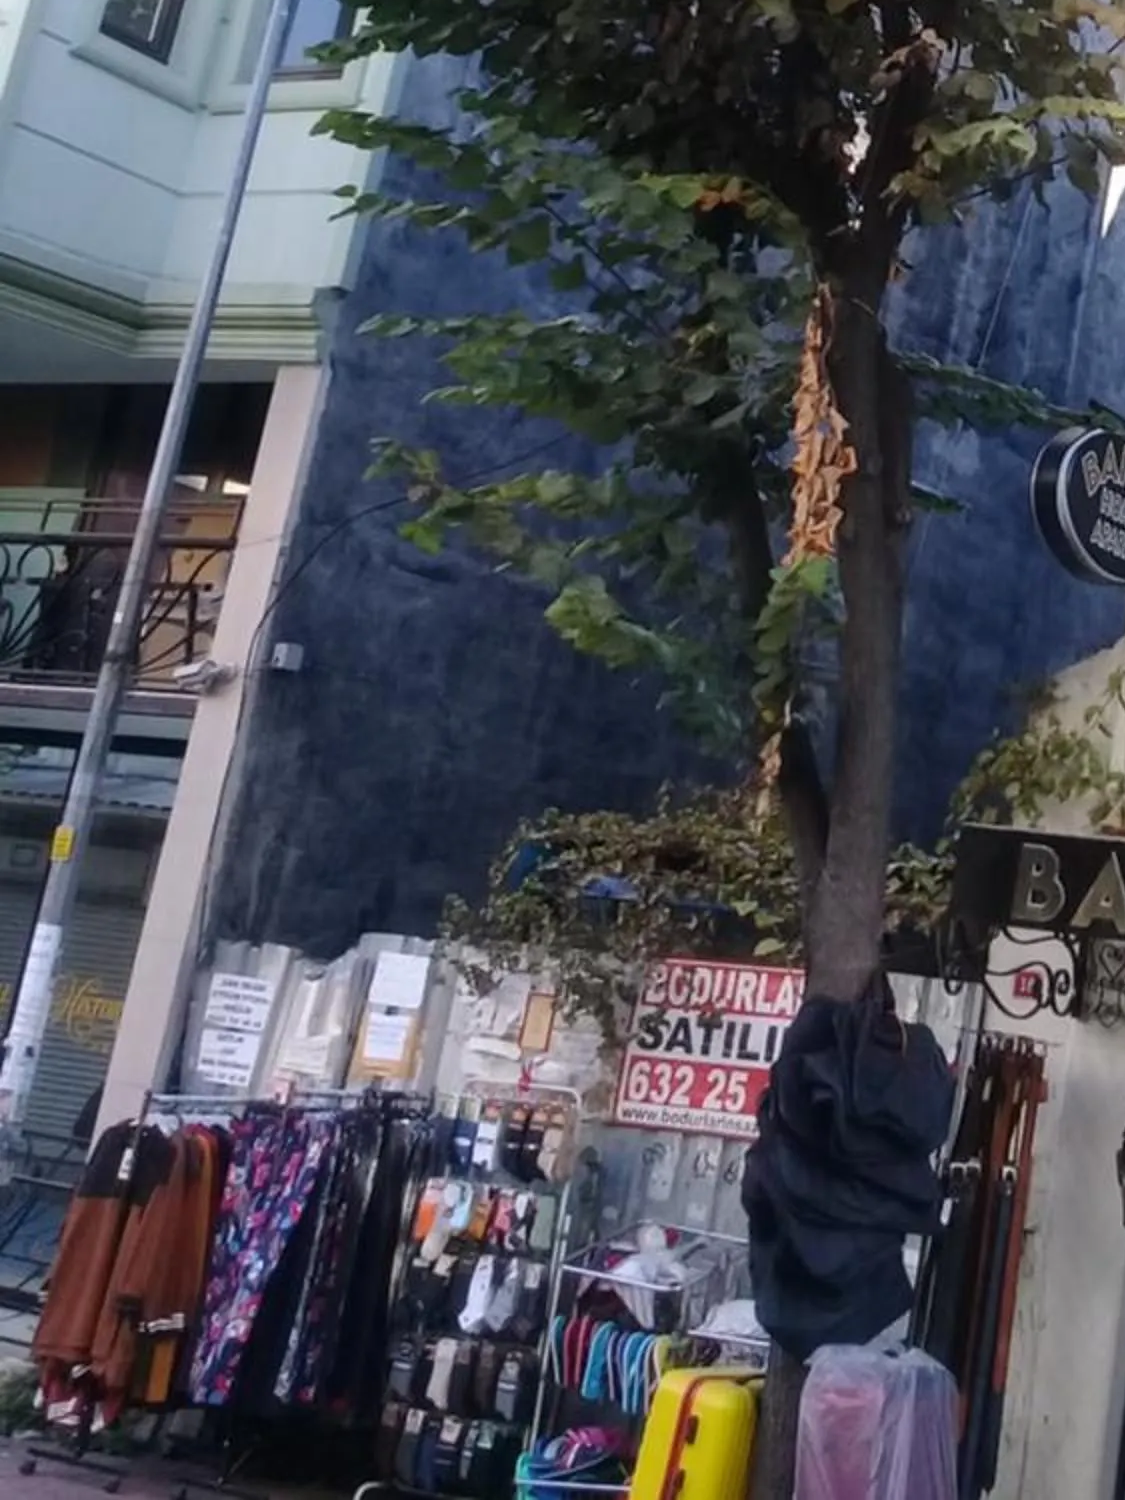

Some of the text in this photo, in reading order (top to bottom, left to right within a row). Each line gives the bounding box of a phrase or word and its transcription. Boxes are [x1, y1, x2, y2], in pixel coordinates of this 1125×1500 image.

[645, 962, 805, 1016] BODURLA
[637, 1011, 779, 1062] SATILI
[628, 1060, 749, 1113] 632 25
